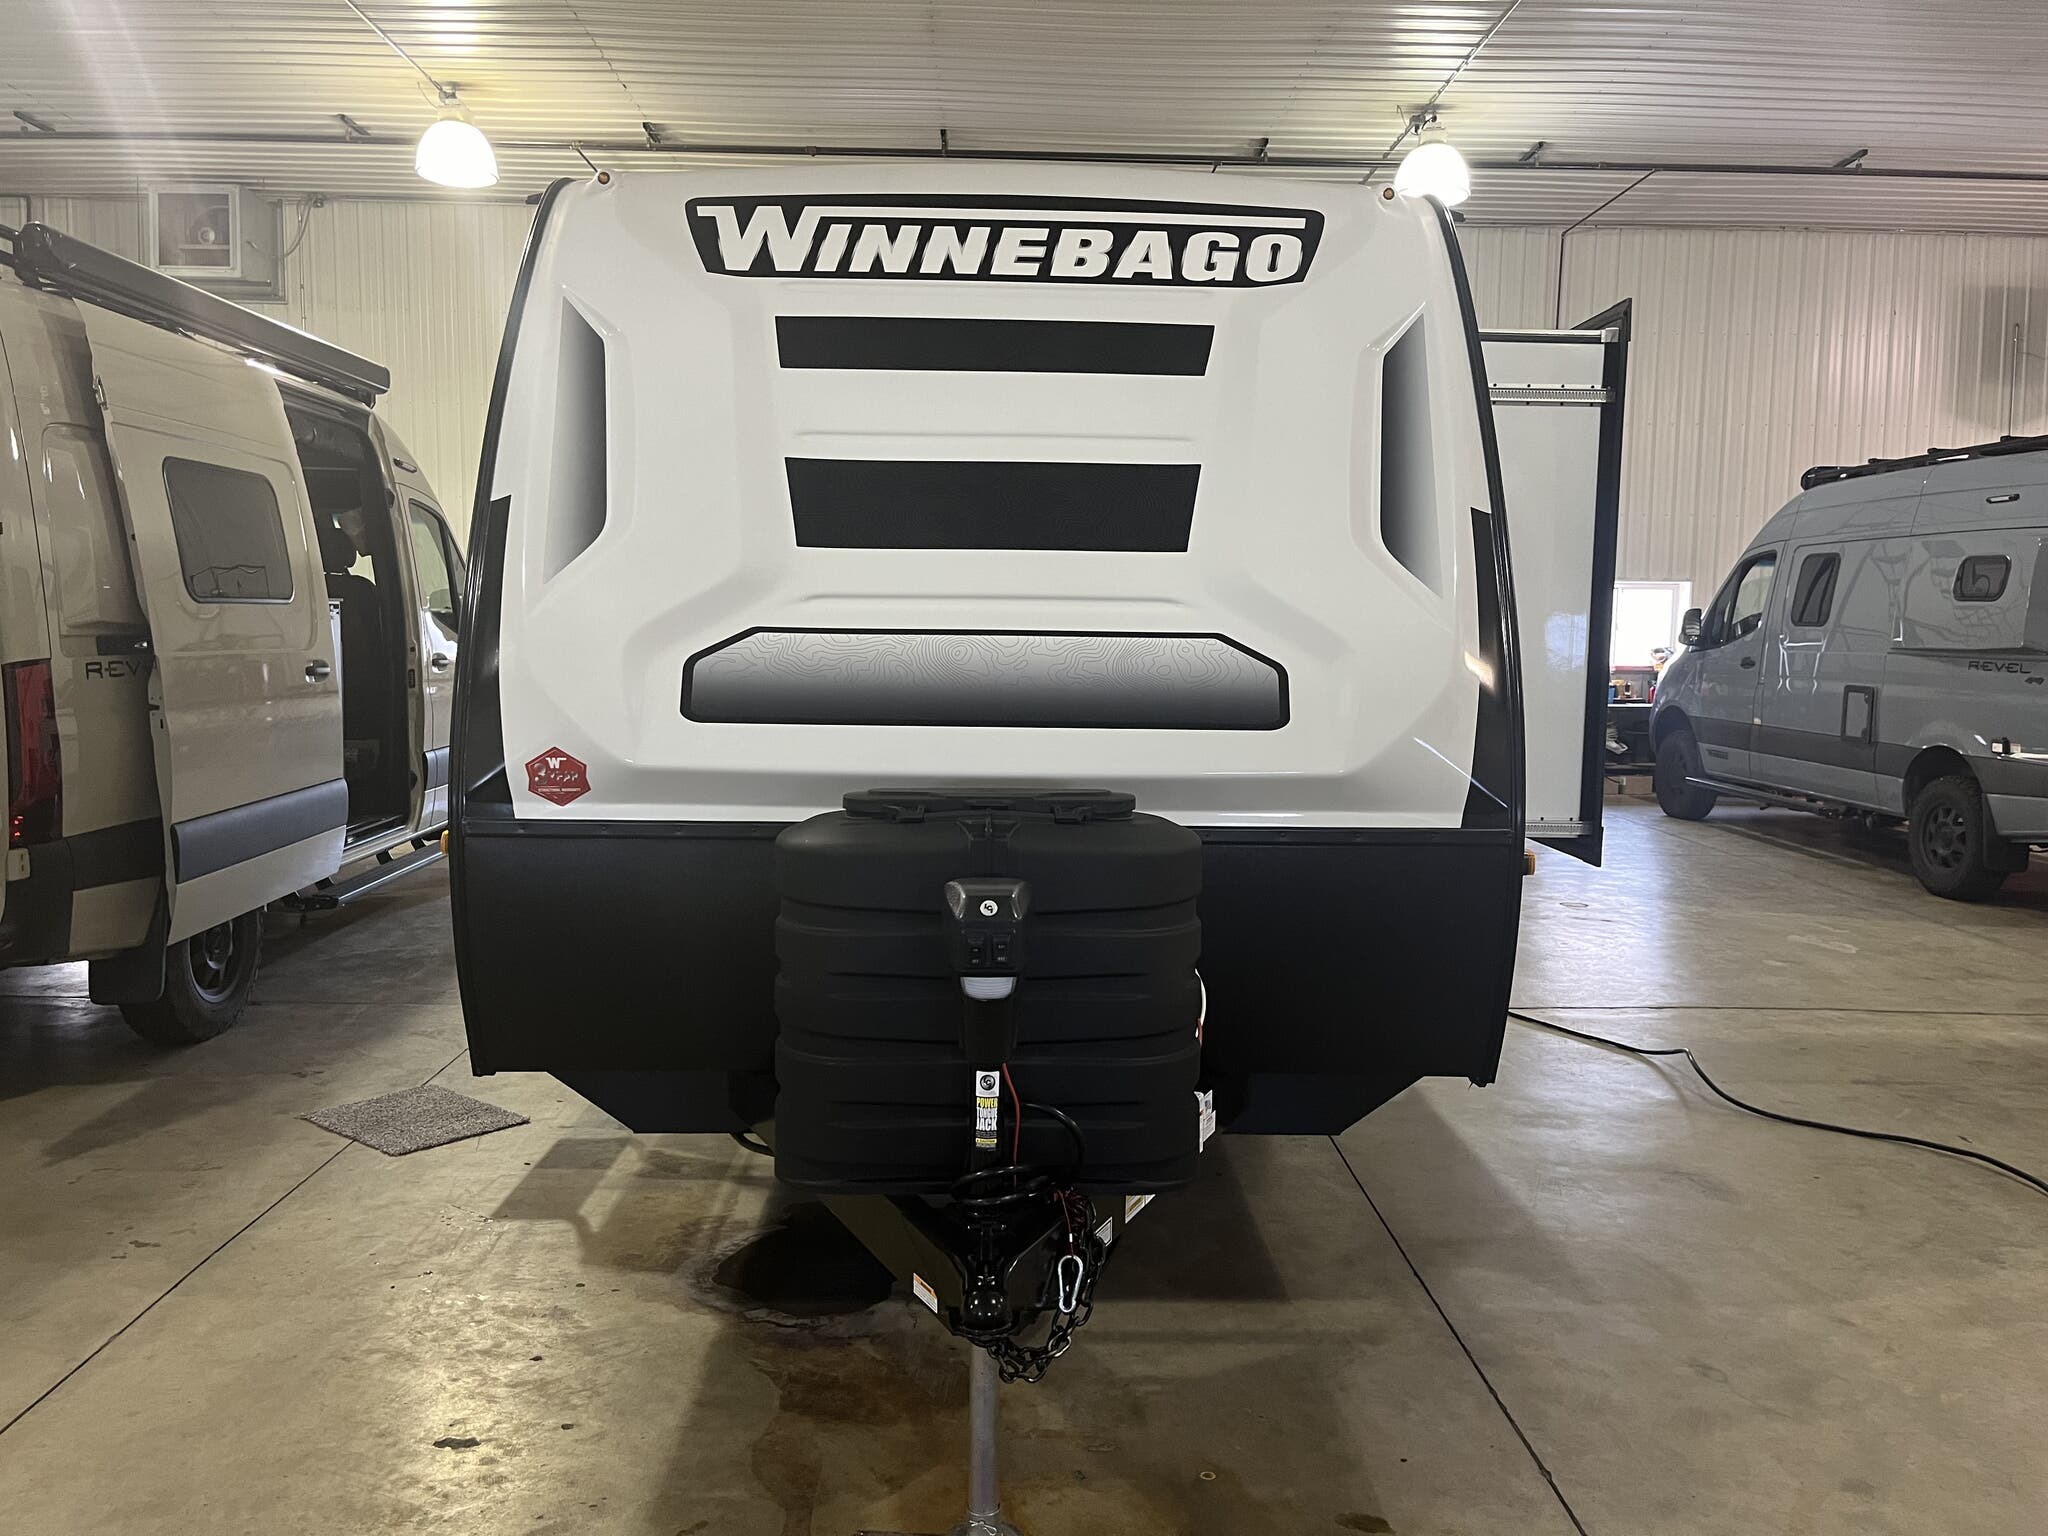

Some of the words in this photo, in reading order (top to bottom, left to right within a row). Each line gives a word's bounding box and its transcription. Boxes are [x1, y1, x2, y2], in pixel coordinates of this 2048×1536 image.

[696, 205, 1306, 283] WINNEBAGO
[86, 660, 152, 680] REV
[1968, 660, 2032, 673] REVEL
[976, 1097, 998, 1108] POWER
[976, 1117, 998, 1131] JACK
